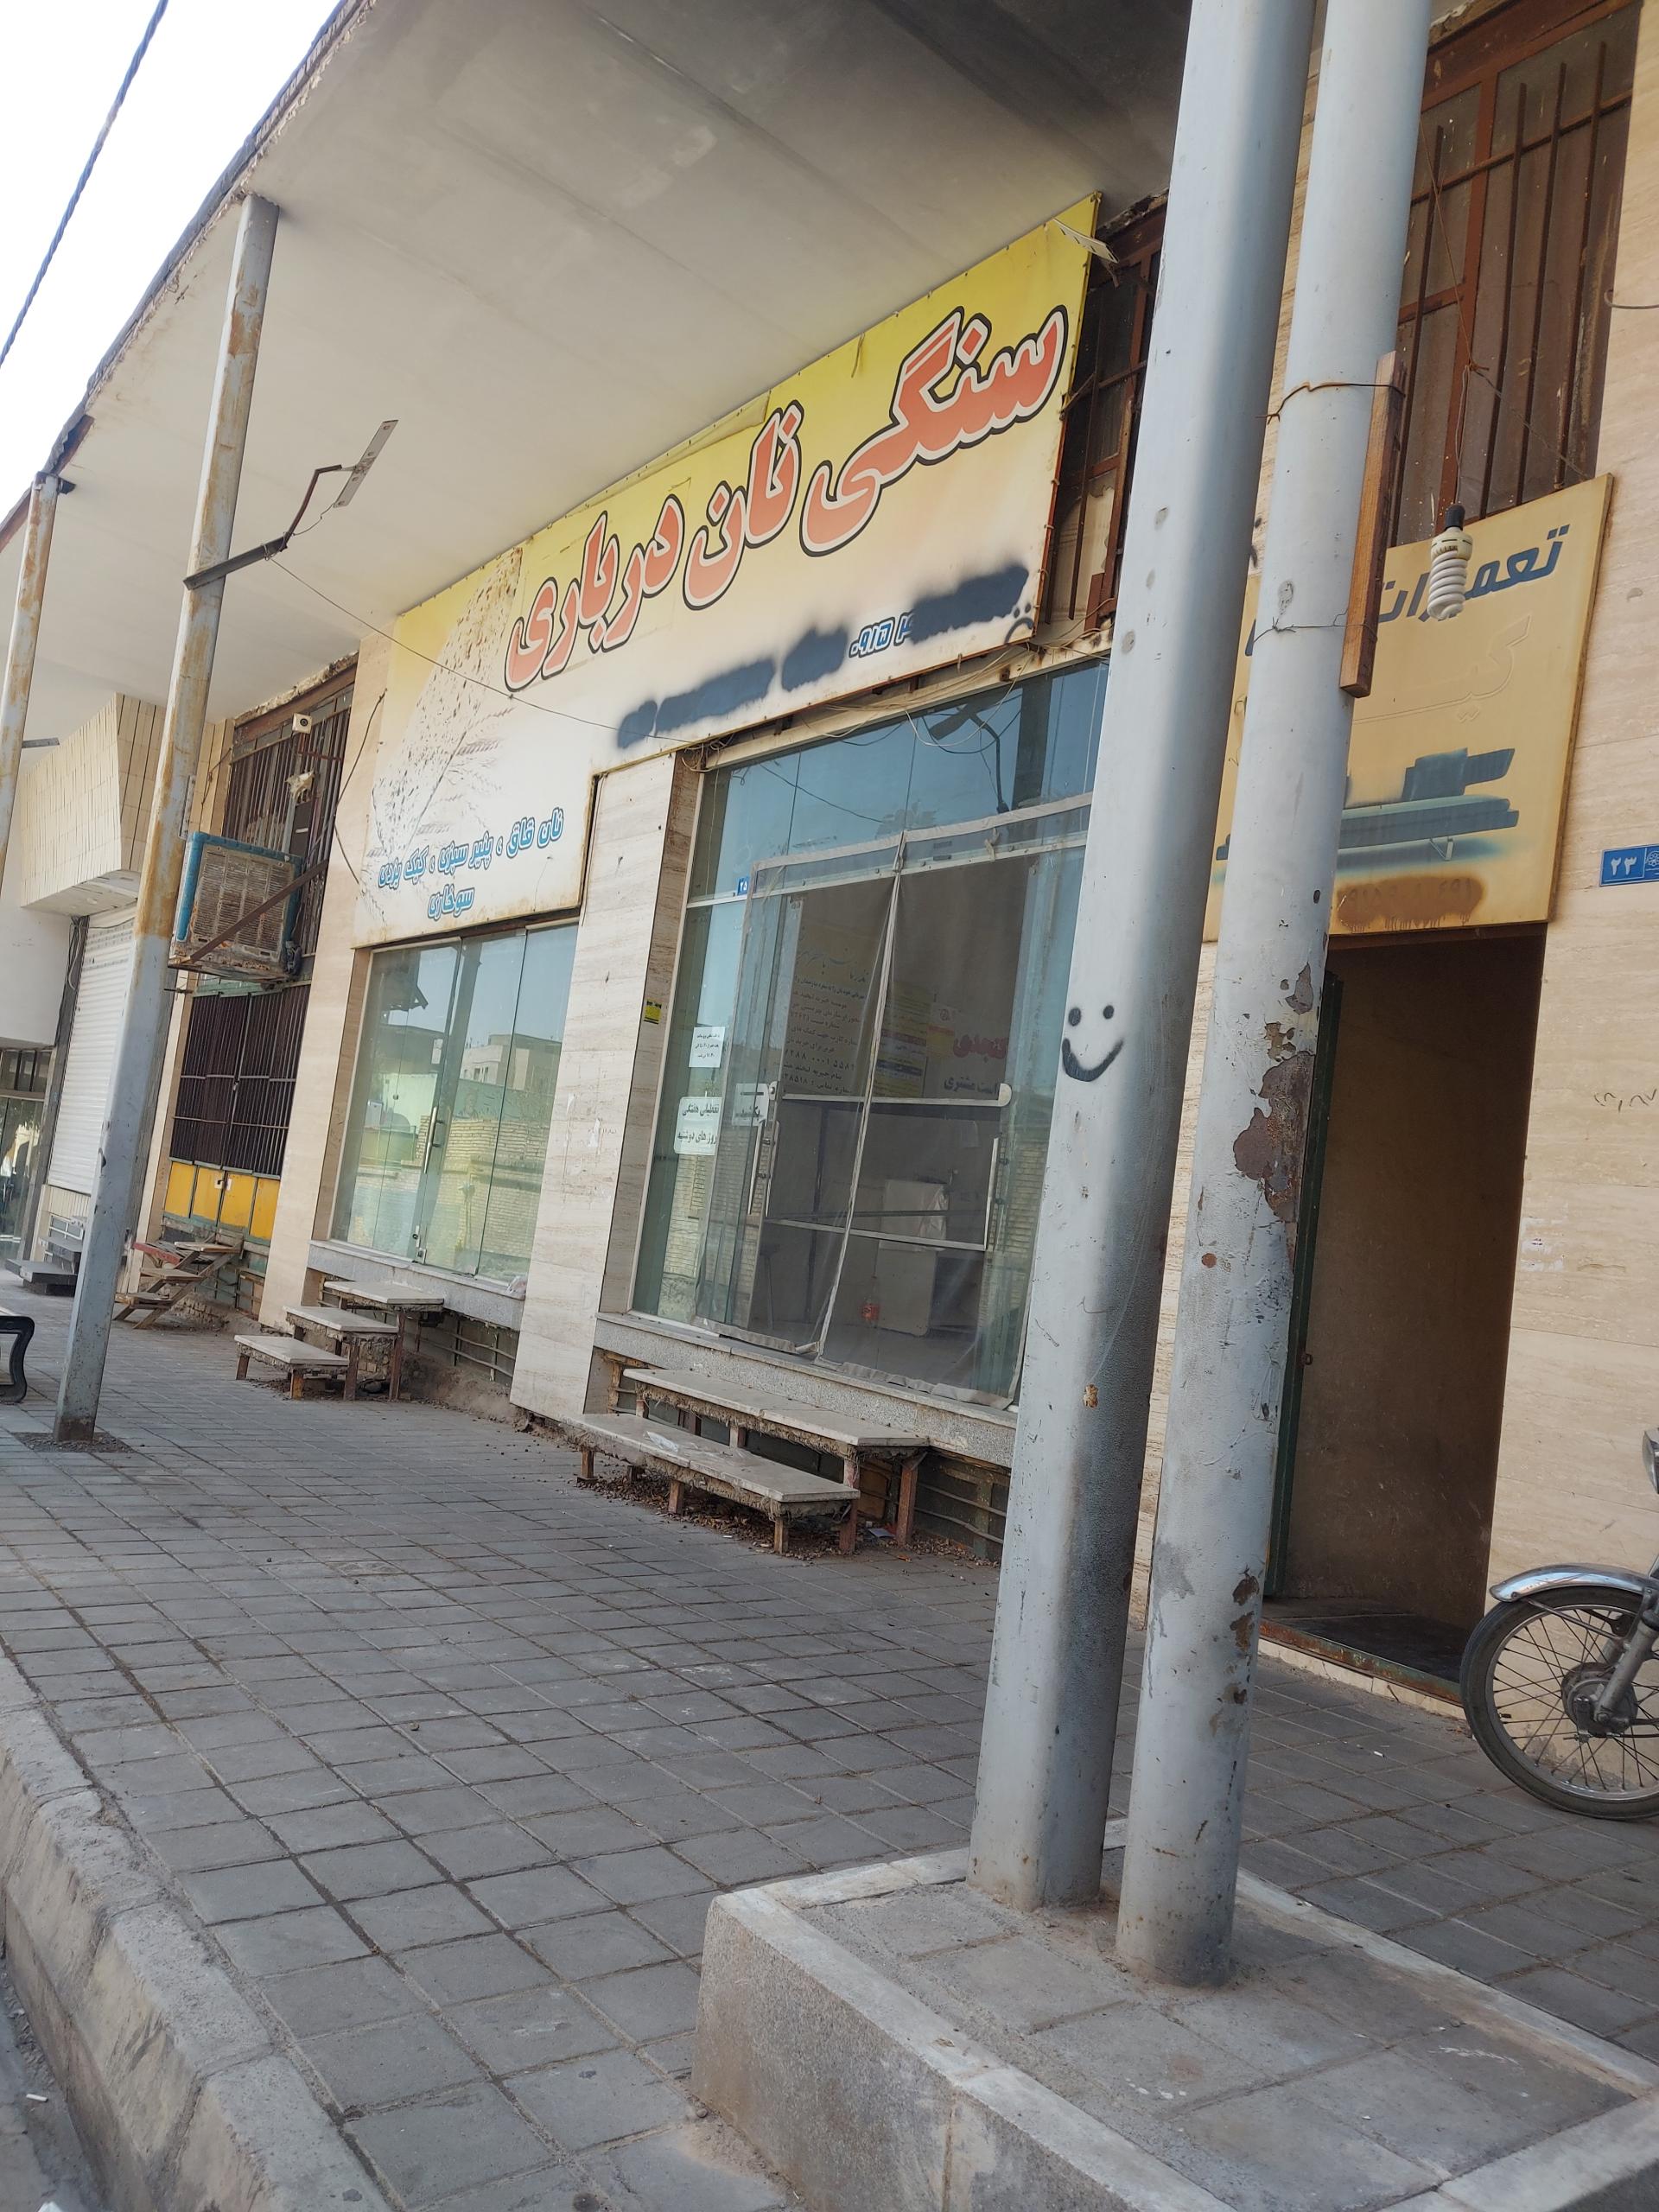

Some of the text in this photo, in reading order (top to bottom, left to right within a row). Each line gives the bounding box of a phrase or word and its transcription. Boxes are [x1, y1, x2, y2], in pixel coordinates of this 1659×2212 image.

[505, 305, 1068, 692] سنگی نان درباری
[1377, 524, 1571, 624] تعمات
[506, 817, 535, 858] قاق
[537, 807, 564, 847] نان
[404, 845, 429, 885] کیک
[468, 830, 494, 869] پنیر
[1610, 856, 1637, 876] ۲۳
[378, 857, 403, 889] یزدی
[428, 884, 475, 920] سوخاری
